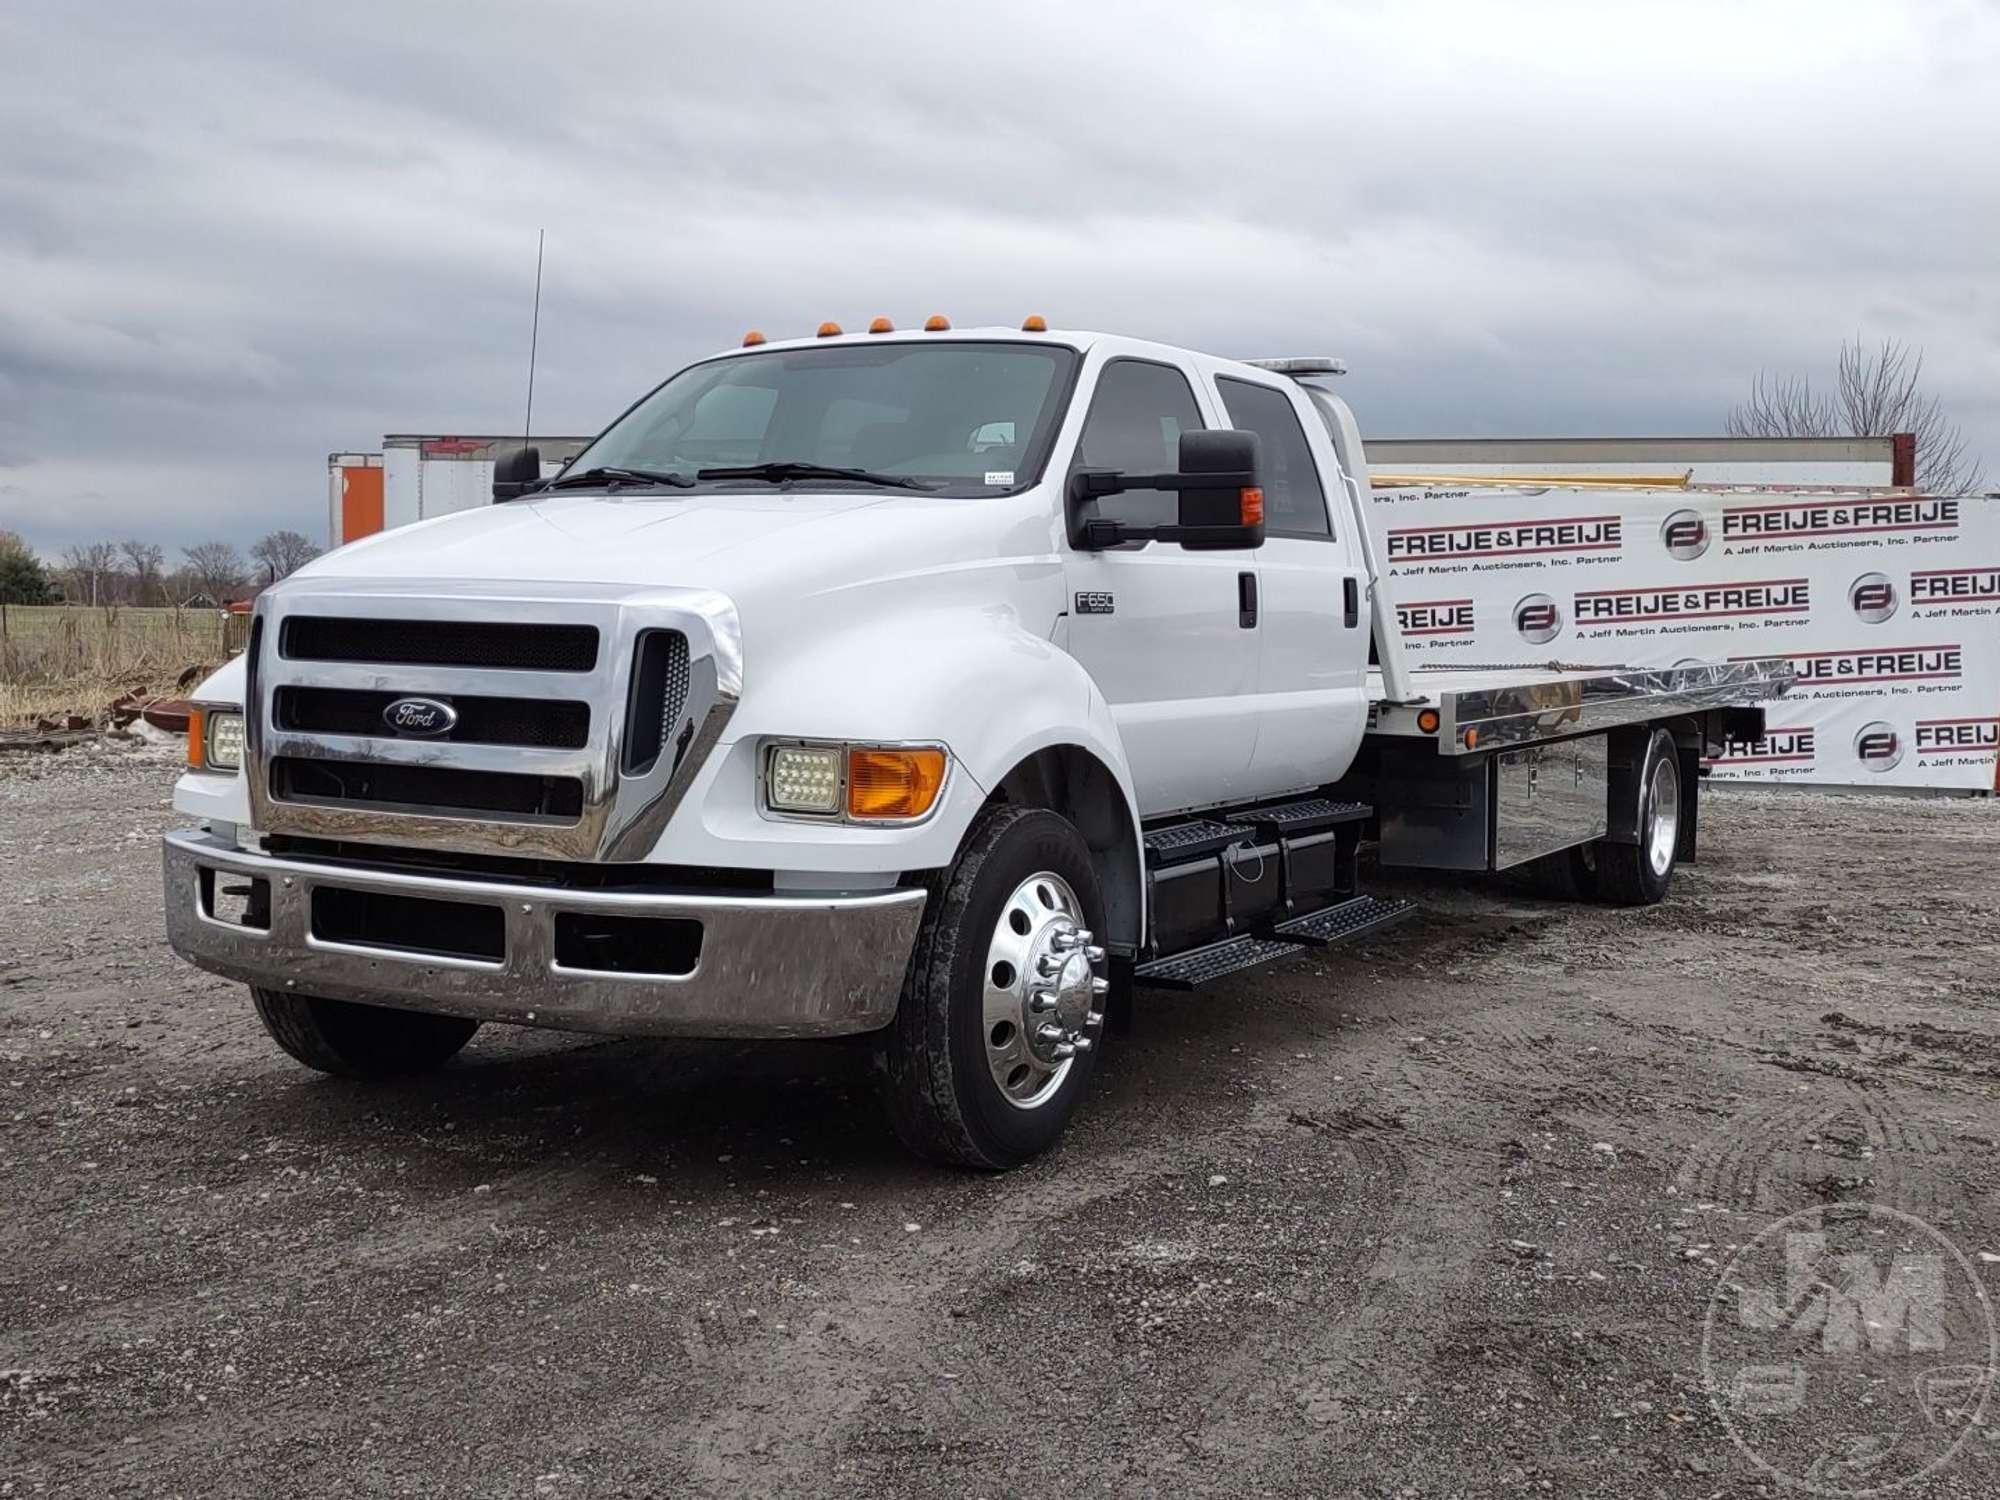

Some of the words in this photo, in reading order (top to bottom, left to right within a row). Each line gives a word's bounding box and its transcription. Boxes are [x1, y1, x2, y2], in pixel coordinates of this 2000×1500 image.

[1399, 493, 1420, 501] Inc.
[1424, 491, 1470, 499] Partner
[1724, 547, 1733, 555] A
[1738, 545, 1759, 554] Jeff
[1764, 543, 1804, 553] Martin
[1808, 539, 1883, 550] Auctioneers,
[1887, 537, 1909, 545] Inc.
[1913, 534, 1960, 543] Partner
[1389, 568, 1398, 576] A
[1402, 566, 1424, 576] Jeff
[1428, 564, 1468, 574] Martin
[1472, 560, 1546, 571] Auctioneers,
[1551, 558, 1572, 566] Inc.
[1576, 555, 1622, 565] Partner
[1077, 593, 1115, 607] F650
[1911, 610, 1921, 618] A
[1925, 608, 1947, 618] Jeff
[1951, 607, 1991, 616] Martin
[1576, 631, 1585, 639] A
[1589, 629, 1612, 638] Jeff
[1616, 627, 1656, 637] Martin
[1659, 624, 1734, 634] Auctioneers,
[1738, 621, 1760, 629] Inc.
[1764, 618, 1810, 627] Partner
[1430, 639, 1475, 648] Partner
[1813, 688, 1887, 699] Auctioneers,
[1891, 686, 1912, 695] Inc.
[1917, 684, 1963, 693] Partner
[396, 703, 435, 726] Ford
[1918, 759, 1927, 767] A
[1932, 758, 1953, 767] Jeff
[1958, 756, 1994, 765] Martin
[1770, 767, 1815, 775] Partner
